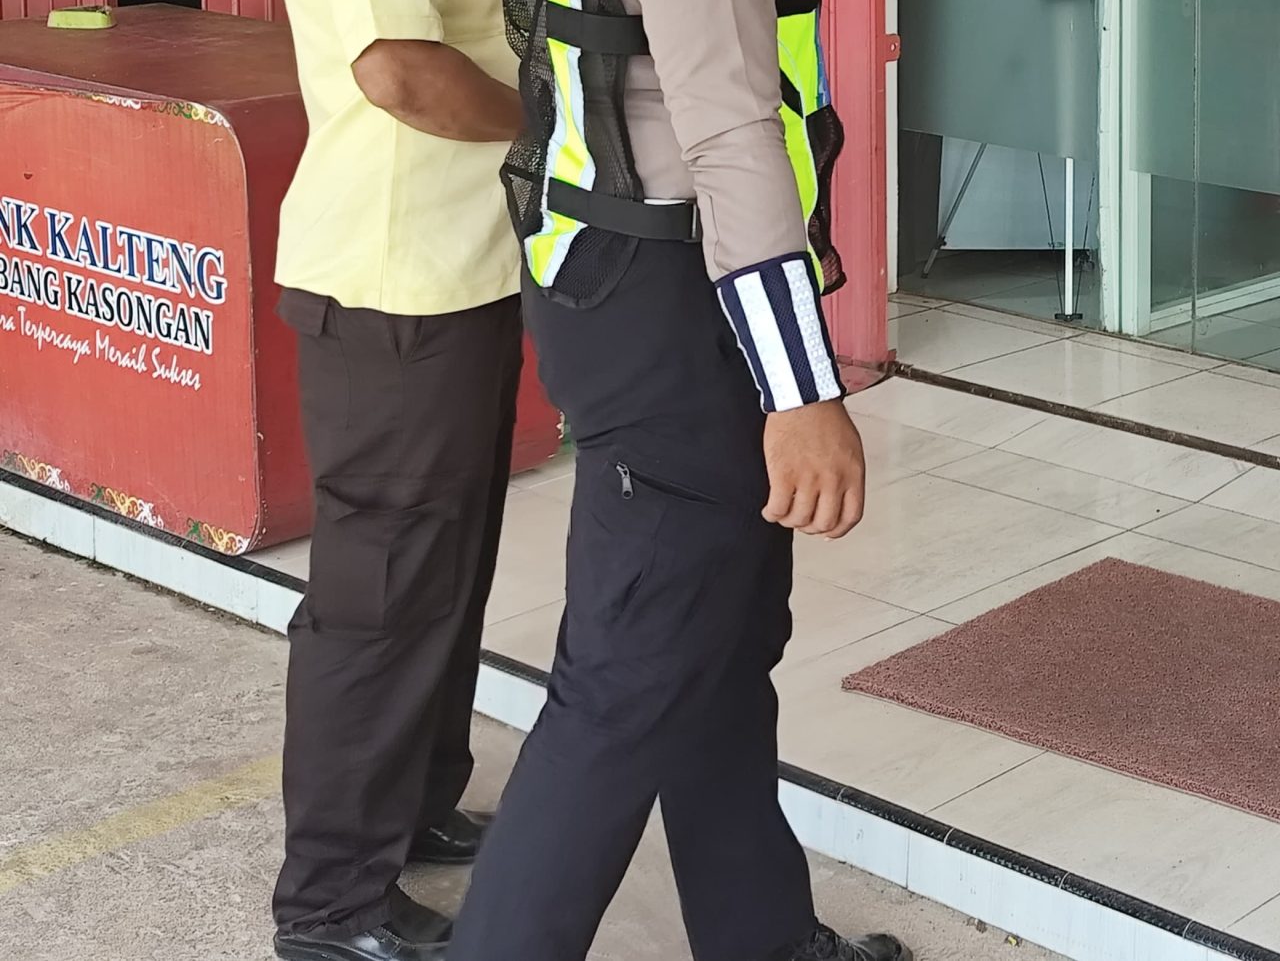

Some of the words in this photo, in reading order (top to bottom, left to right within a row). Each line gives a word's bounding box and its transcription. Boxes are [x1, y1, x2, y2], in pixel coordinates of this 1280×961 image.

[45, 208, 227, 302] KALTENG
[17, 305, 91, 365] Terpercaya
[96, 328, 148, 374] Meraih
[152, 346, 202, 391] Sukses
[66, 275, 211, 352] KASONGAN
